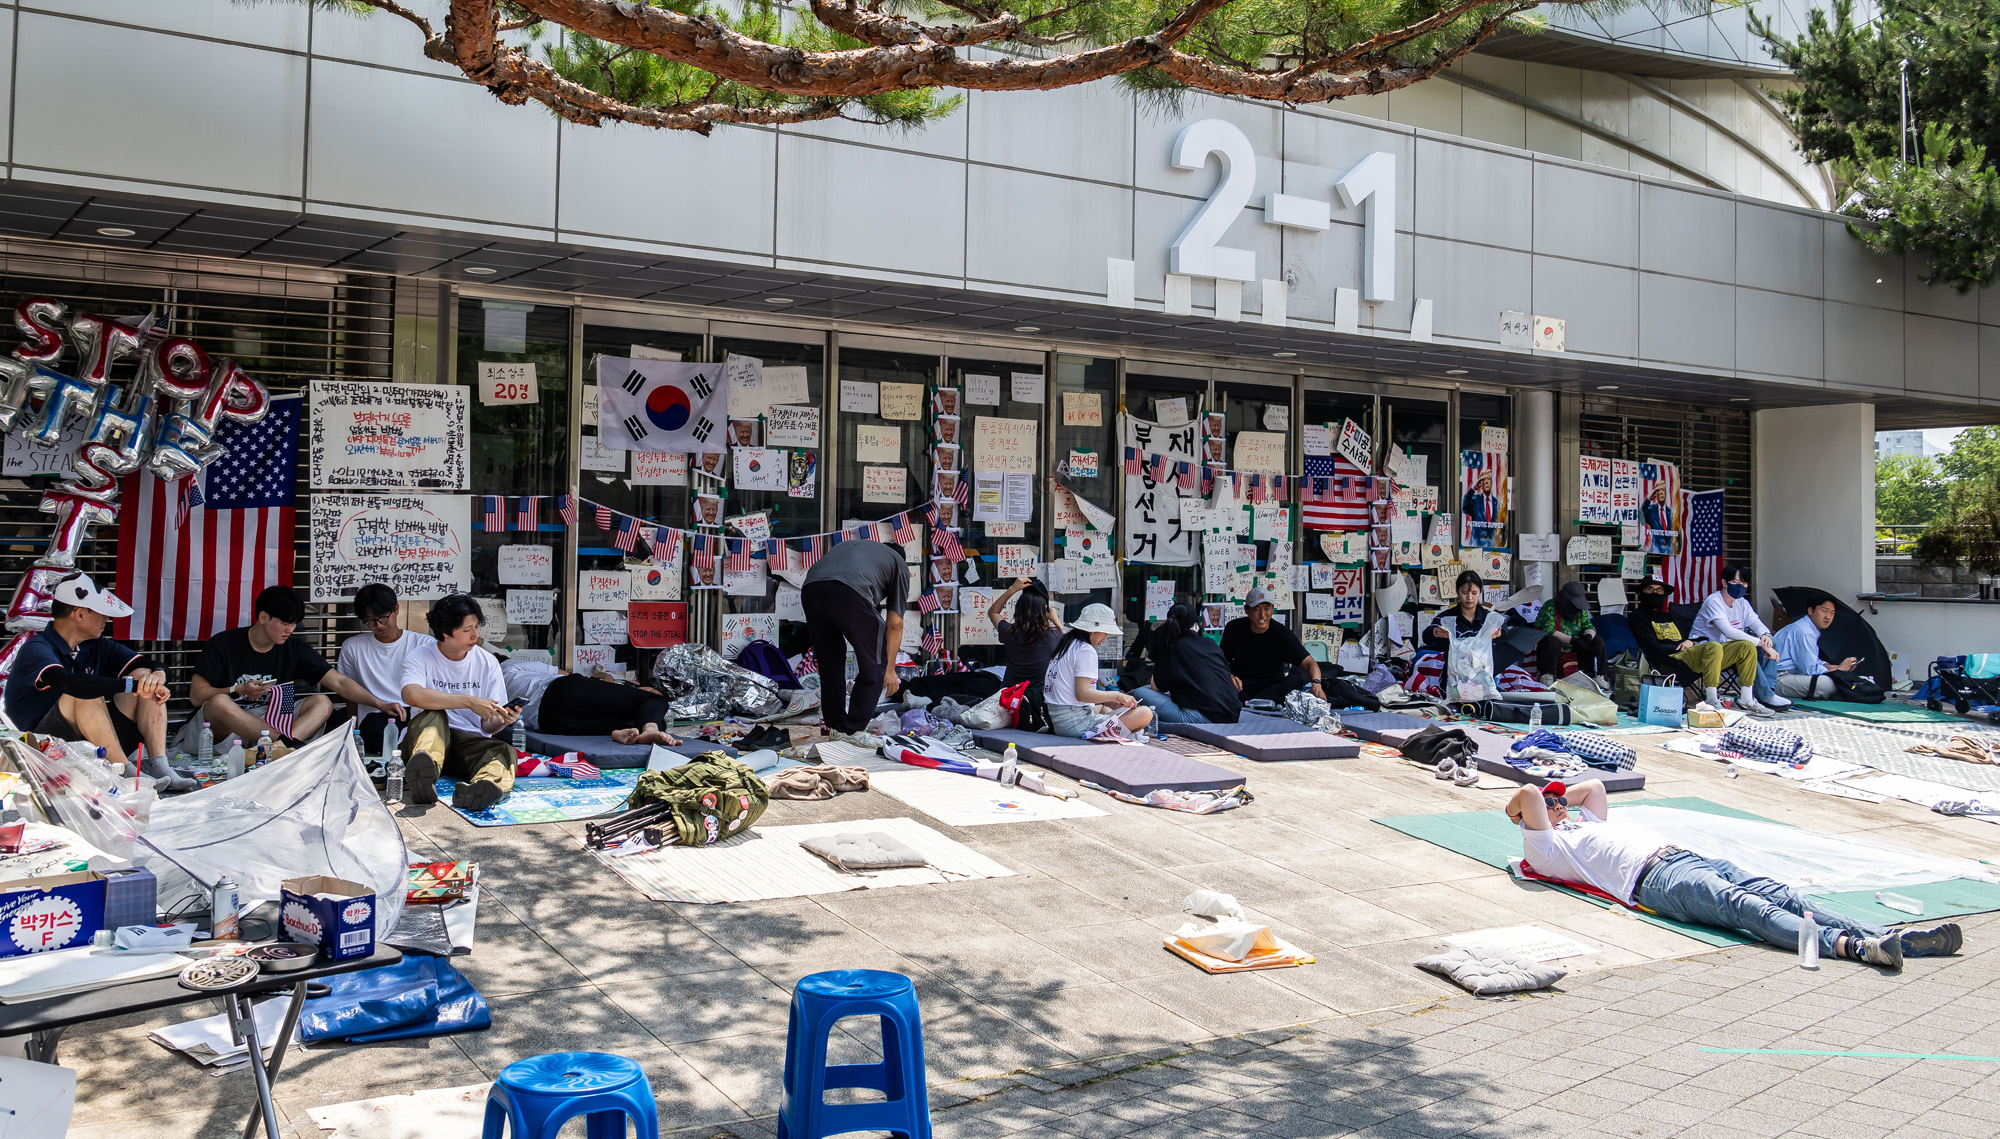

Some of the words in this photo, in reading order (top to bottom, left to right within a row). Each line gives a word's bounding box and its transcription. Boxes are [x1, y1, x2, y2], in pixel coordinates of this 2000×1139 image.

[1171, 118, 1396, 302] 2-1
[14, 295, 270, 428] STOP
[487, 366, 506, 381] 최소
[508, 366, 525, 380] 상주
[495, 383, 528, 400] 20명
[981, 422, 1011, 435] 투표용지
[988, 438, 1019, 450] 증거보존
[1342, 437, 1372, 470] 수사해!
[6, 457, 23, 468] the
[979, 455, 1007, 468] 부정선거
[1009, 456, 1033, 468] 진상규명
[1071, 455, 1098, 469] 재선거
[1581, 458, 1609, 472] 국제기관
[1615, 477, 1638, 489] 선관위
[1581, 490, 1609, 504] 한미공조
[1614, 493, 1629, 507] 몸통
[1581, 506, 1609, 521] 국제수사
[353, 516, 391, 537] 공정한
[395, 519, 427, 534] 선거하는
[429, 521, 448, 536] 방법
[1467, 520, 1487, 529] PATRIOTIC
[999, 547, 1022, 559] 투표용지
[589, 575, 619, 591] 부정선거
[1333, 567, 1364, 596] 증거
[1333, 596, 1362, 621] 보전
[631, 612, 649, 621] 우리의
[633, 630, 648, 638] STOP
[17, 892, 39, 905] Your
[346, 907, 367, 917] 박카스
[20, 909, 74, 931] 박카스
[41, 931, 54, 946] F
